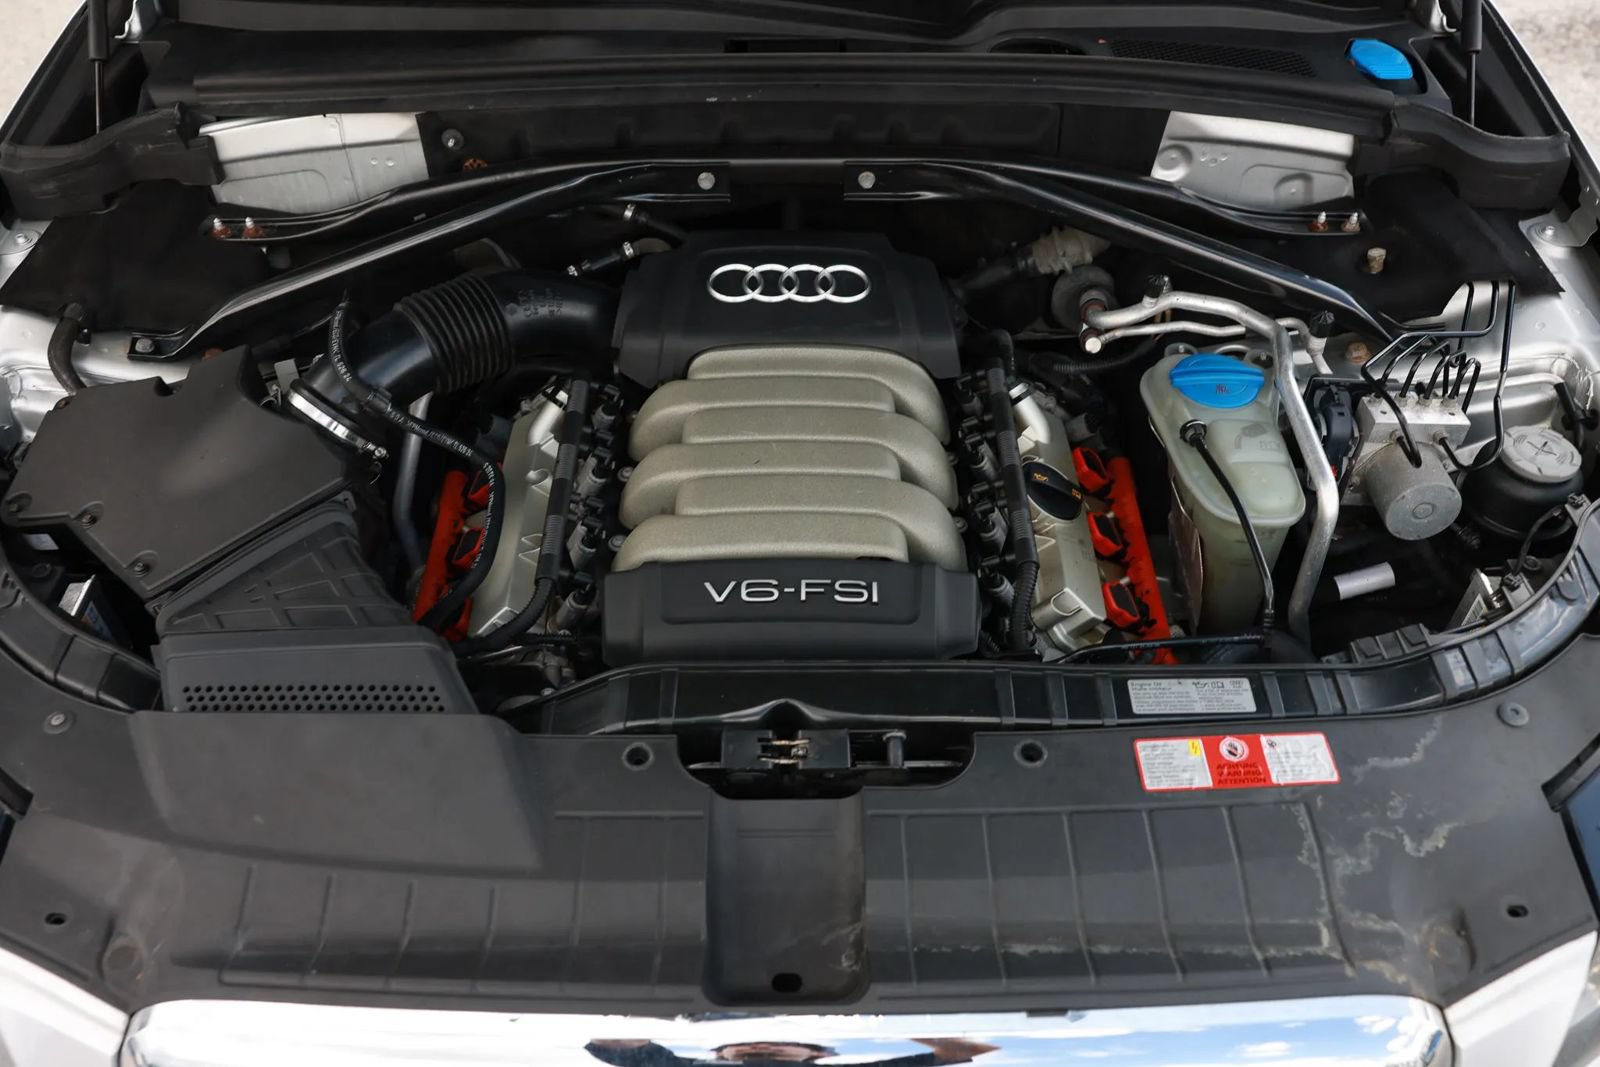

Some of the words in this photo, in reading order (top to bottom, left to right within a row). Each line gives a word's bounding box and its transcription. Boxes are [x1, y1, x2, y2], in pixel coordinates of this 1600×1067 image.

[703, 579, 878, 603] V6-FSI
[1216, 762, 1258, 770] ACHTUNG
[1217, 769, 1262, 777] WARNING
[1217, 776, 1267, 784] ATTENTION
